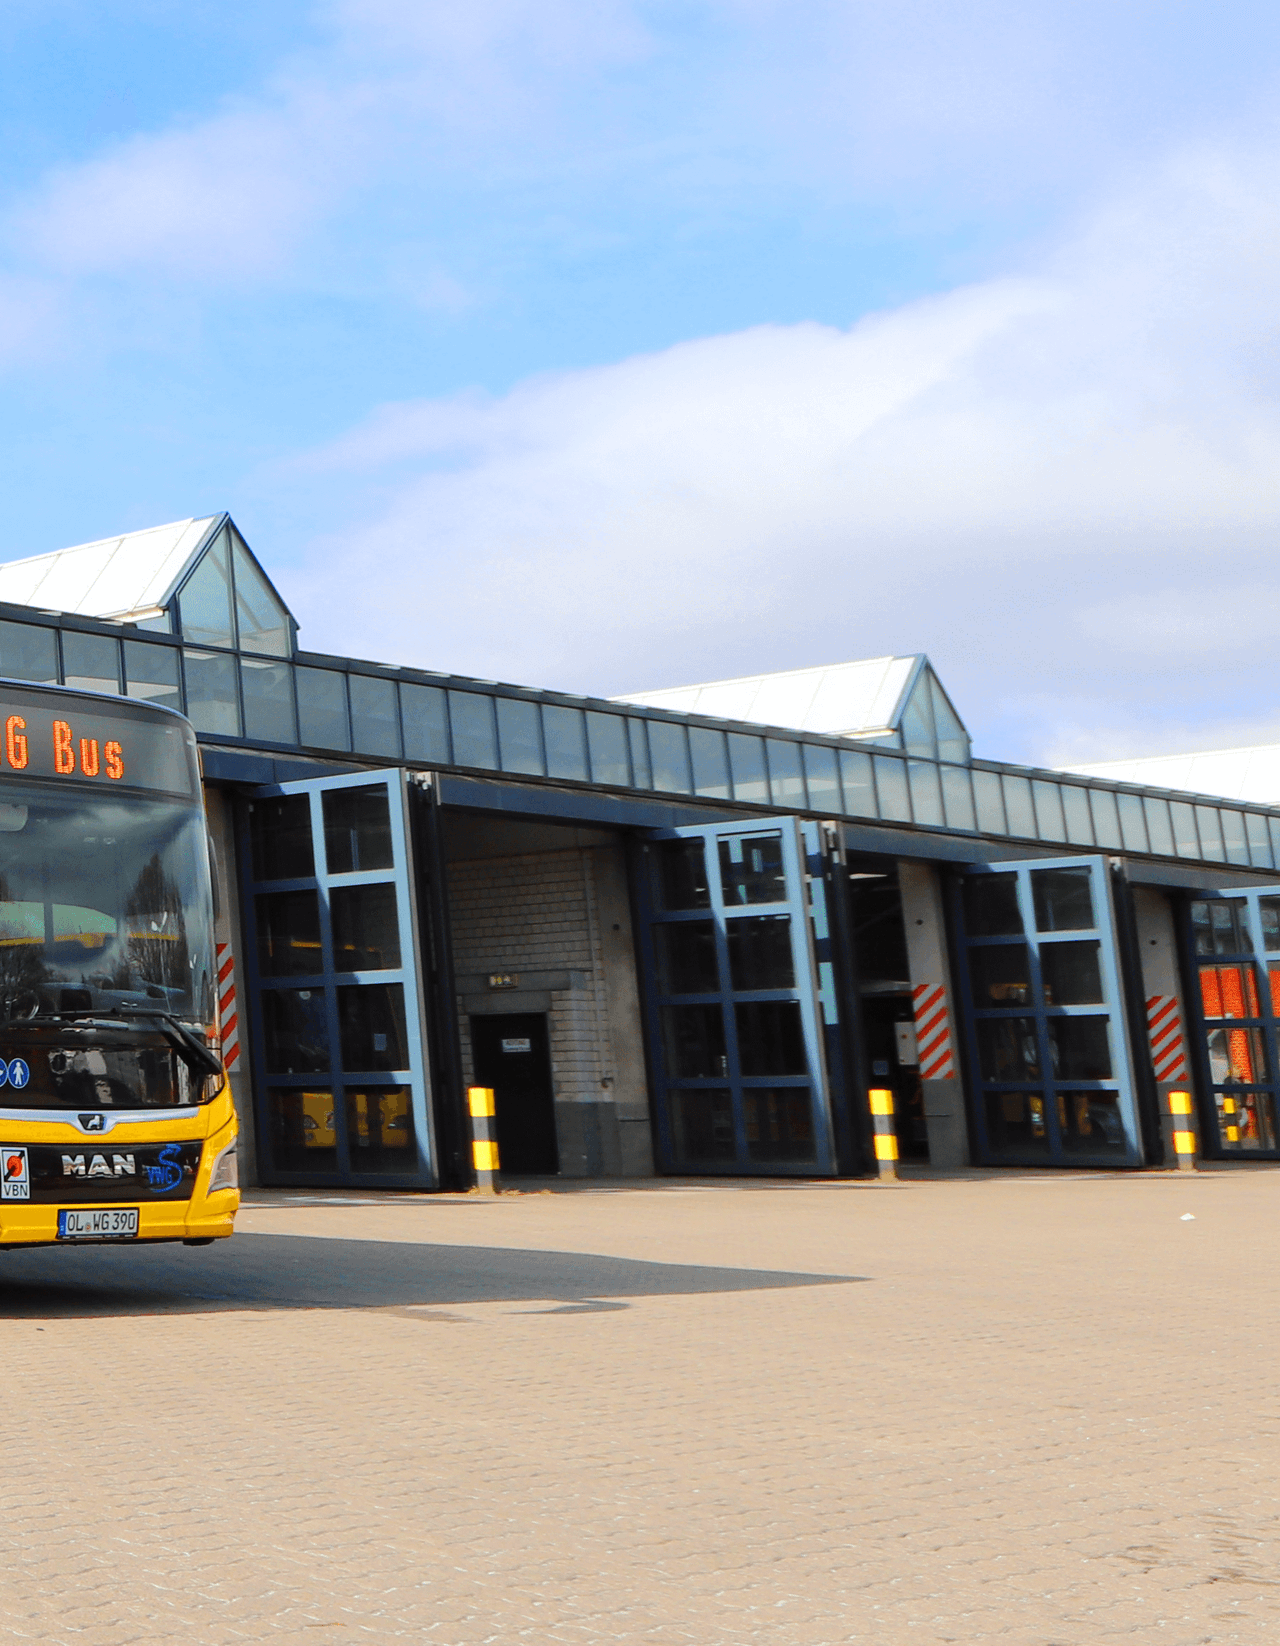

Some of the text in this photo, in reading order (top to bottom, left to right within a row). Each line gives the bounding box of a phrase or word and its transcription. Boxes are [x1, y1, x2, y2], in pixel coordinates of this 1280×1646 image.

[52, 720, 125, 780] Bus
[61, 1154, 136, 1175] MAN
[147, 1167, 173, 1185] VWG
[3, 1184, 28, 1197] VBN
[67, 1213, 84, 1232] OL
[93, 1213, 110, 1231] WG
[112, 1212, 136, 1230] 390
